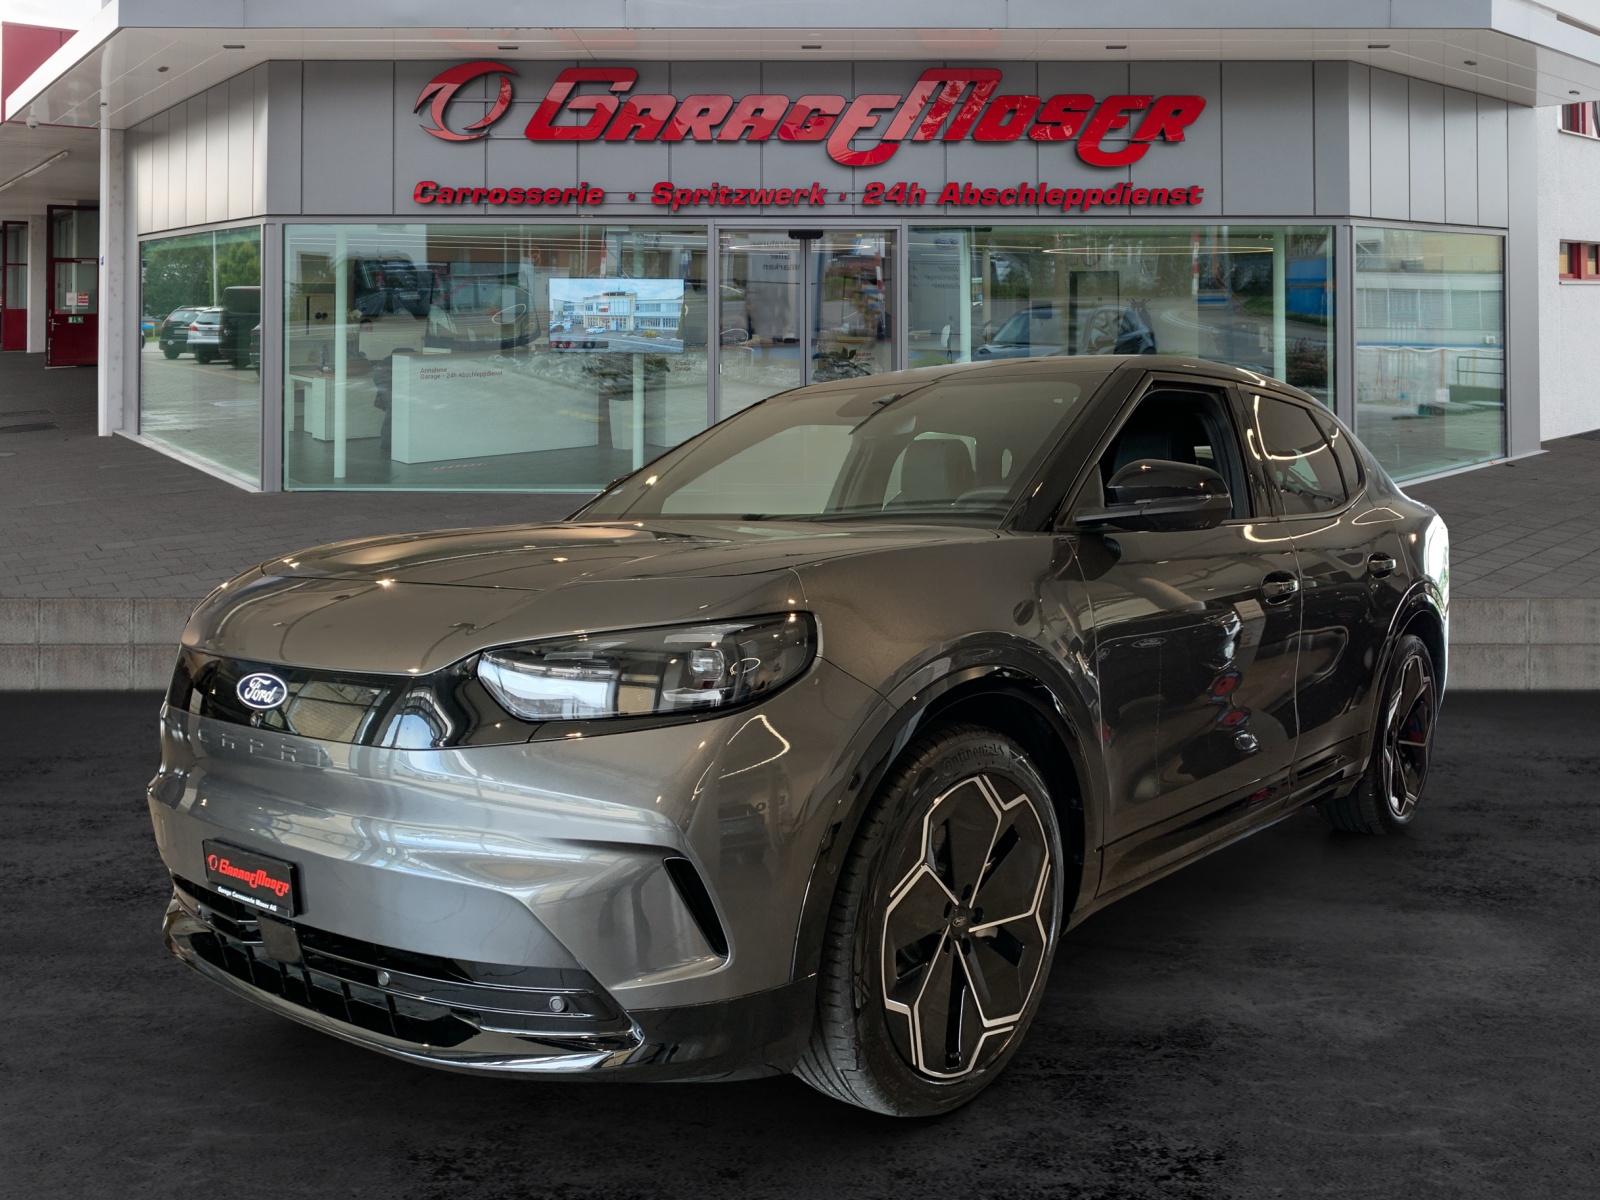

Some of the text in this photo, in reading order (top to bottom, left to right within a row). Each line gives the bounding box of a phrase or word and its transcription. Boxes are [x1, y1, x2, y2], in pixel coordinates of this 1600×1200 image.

[413, 181, 1204, 211] Carrosserie Spritzwerk 24h Abschleppdienst
[243, 676, 279, 705] Ford
